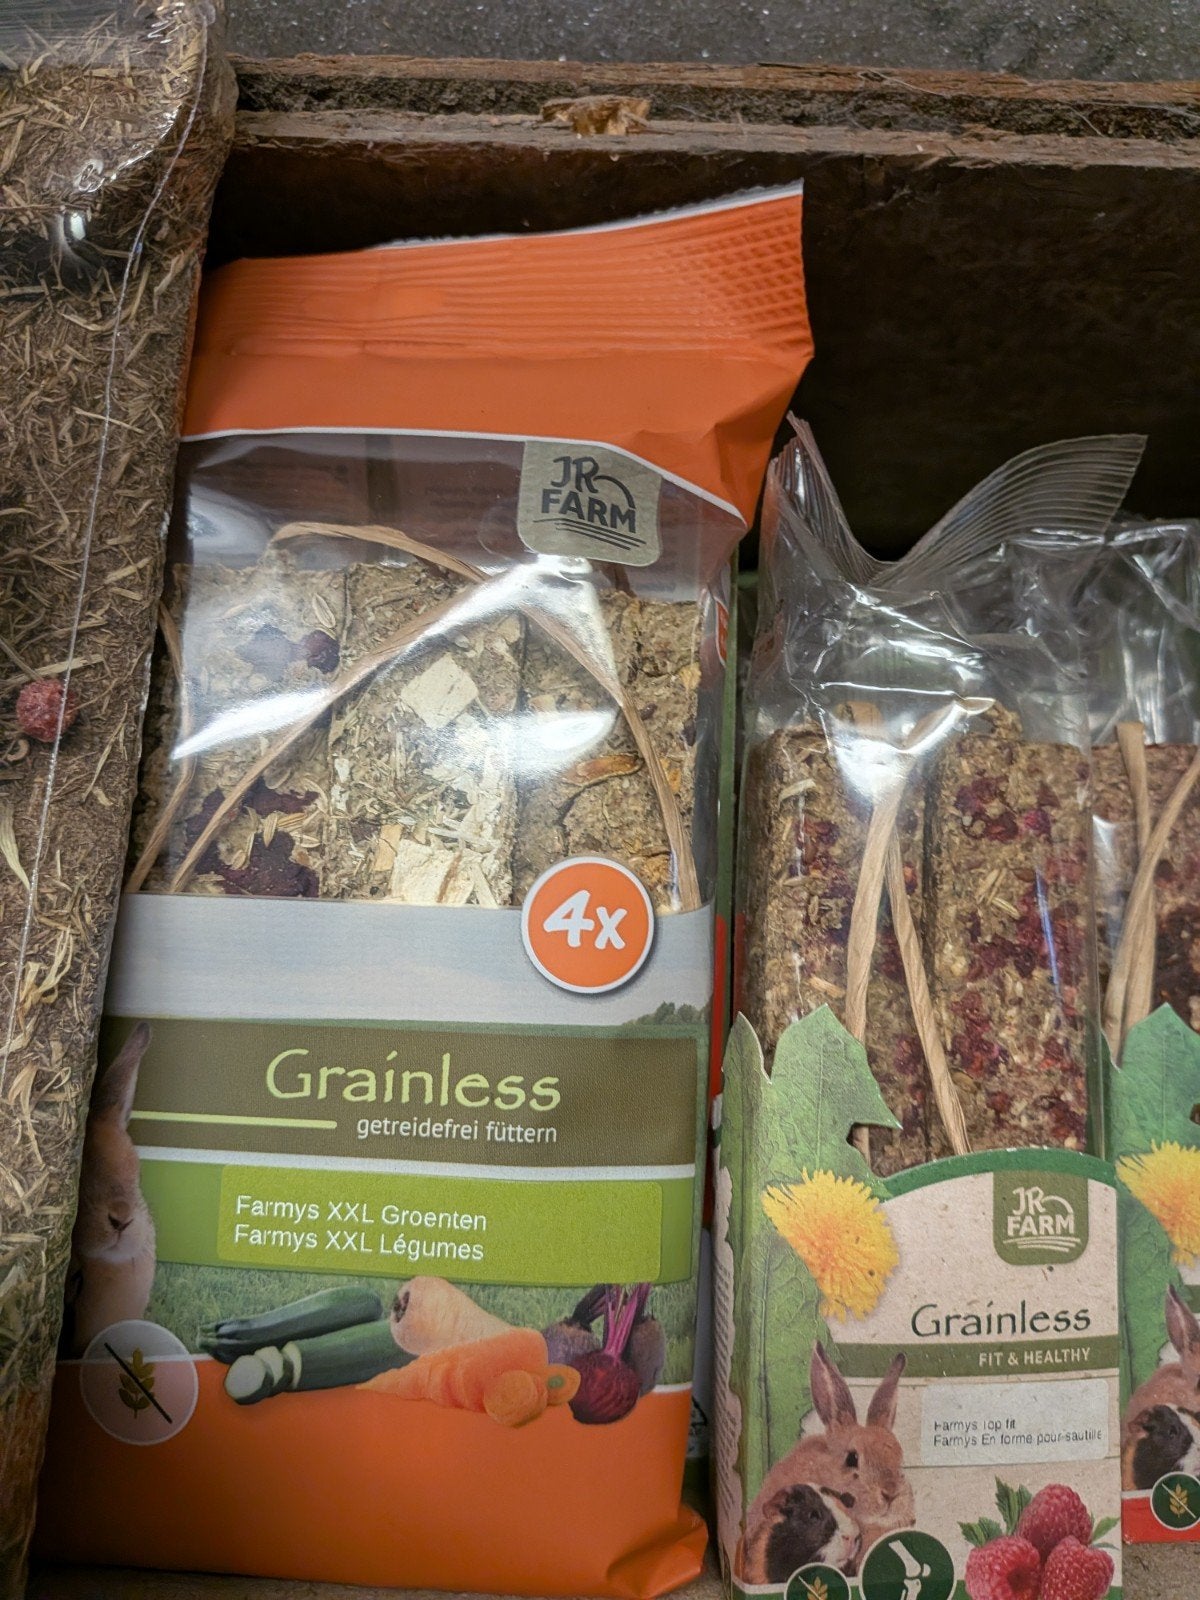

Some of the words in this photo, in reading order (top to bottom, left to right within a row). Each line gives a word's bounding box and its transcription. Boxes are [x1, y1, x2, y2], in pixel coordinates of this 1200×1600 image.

[551, 456, 600, 493] JR
[541, 488, 636, 533] FARM
[265, 1048, 562, 1112] Grainless
[356, 1117, 478, 1140] getreidefrei
[486, 1120, 557, 1143] füttern
[236, 1195, 320, 1223] Farmys
[327, 1202, 374, 1223] XXL
[381, 1205, 487, 1231] Groenten
[1012, 1186, 1046, 1215] JR
[1007, 1214, 1075, 1236] FARM
[234, 1224, 318, 1252] Farmys
[325, 1231, 373, 1252] XXL
[380, 1234, 484, 1262] Légumes
[911, 1300, 1091, 1337] Grainless
[978, 1353, 1003, 1367] FIT
[1007, 1353, 1019, 1366] &
[1024, 1347, 1090, 1365] HEALTHY
[934, 1419, 978, 1432] Farmys
[934, 1434, 977, 1448] Farmys
[981, 1433, 996, 1447] En
[1000, 1432, 1033, 1446] forme
